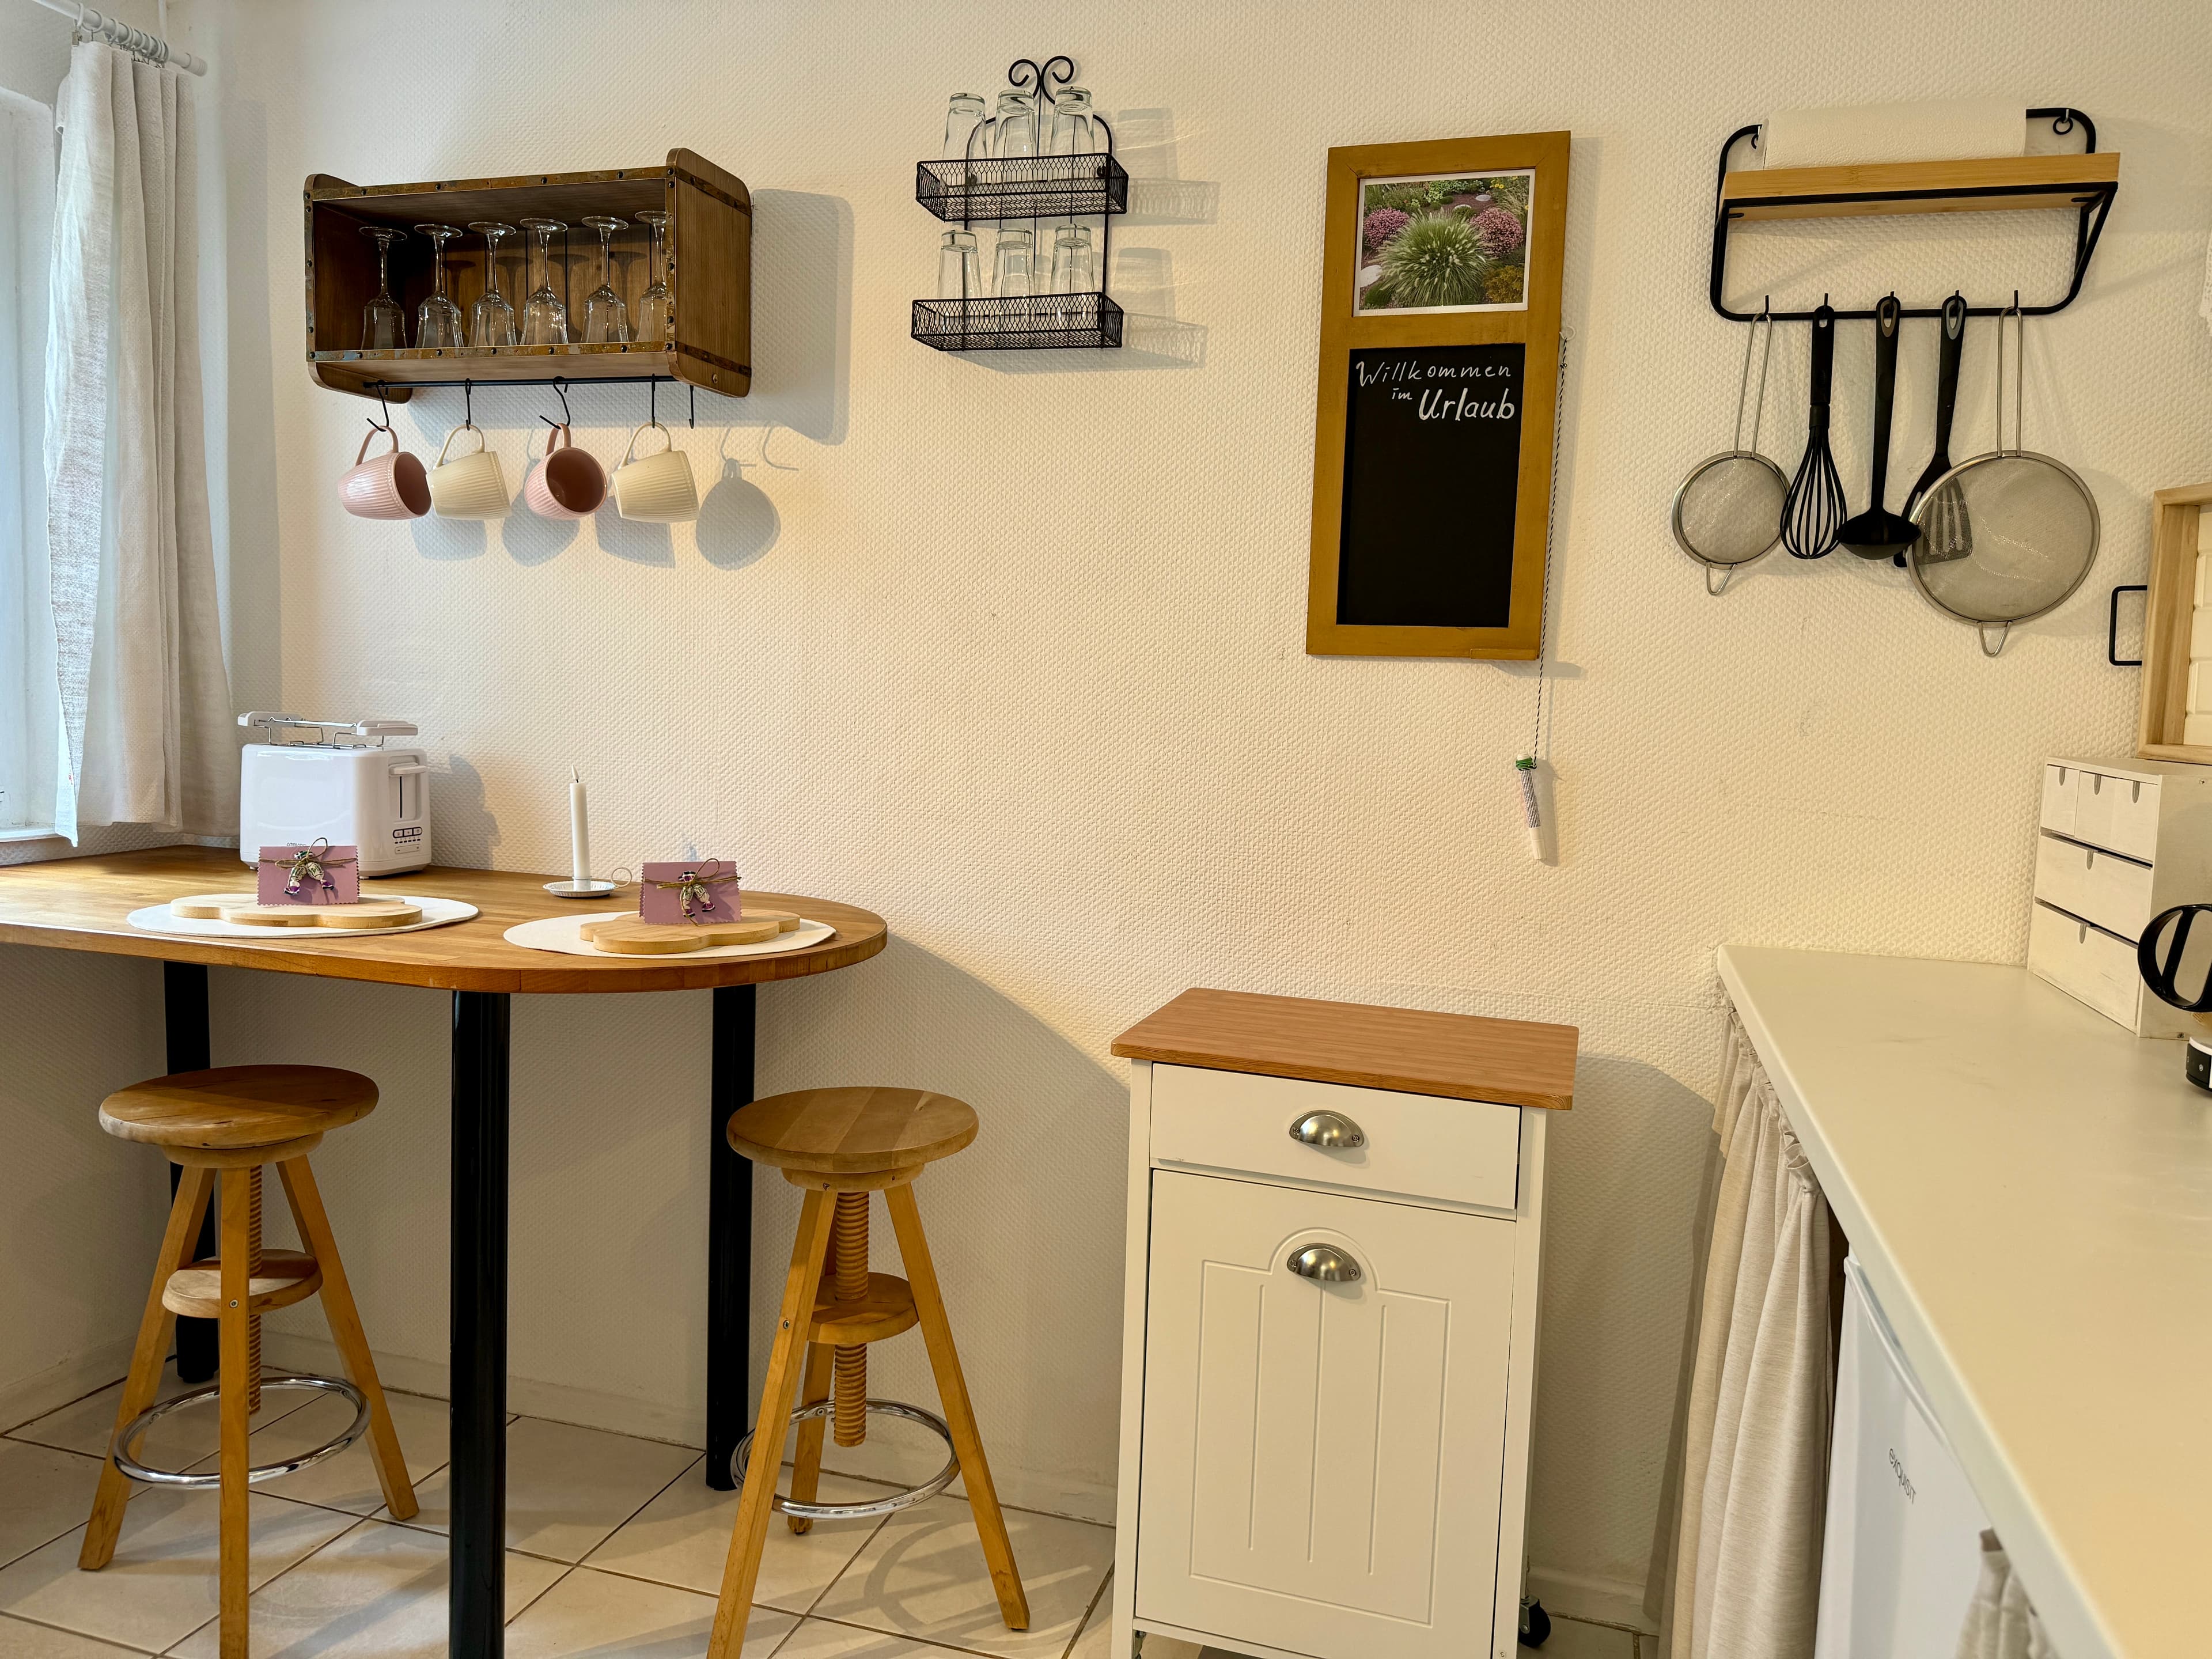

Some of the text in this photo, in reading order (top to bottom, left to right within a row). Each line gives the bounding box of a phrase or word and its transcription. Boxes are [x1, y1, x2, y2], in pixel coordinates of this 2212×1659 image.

[1355, 360, 1512, 387] Willkommen
[1392, 387, 1515, 421] im Urlaub
